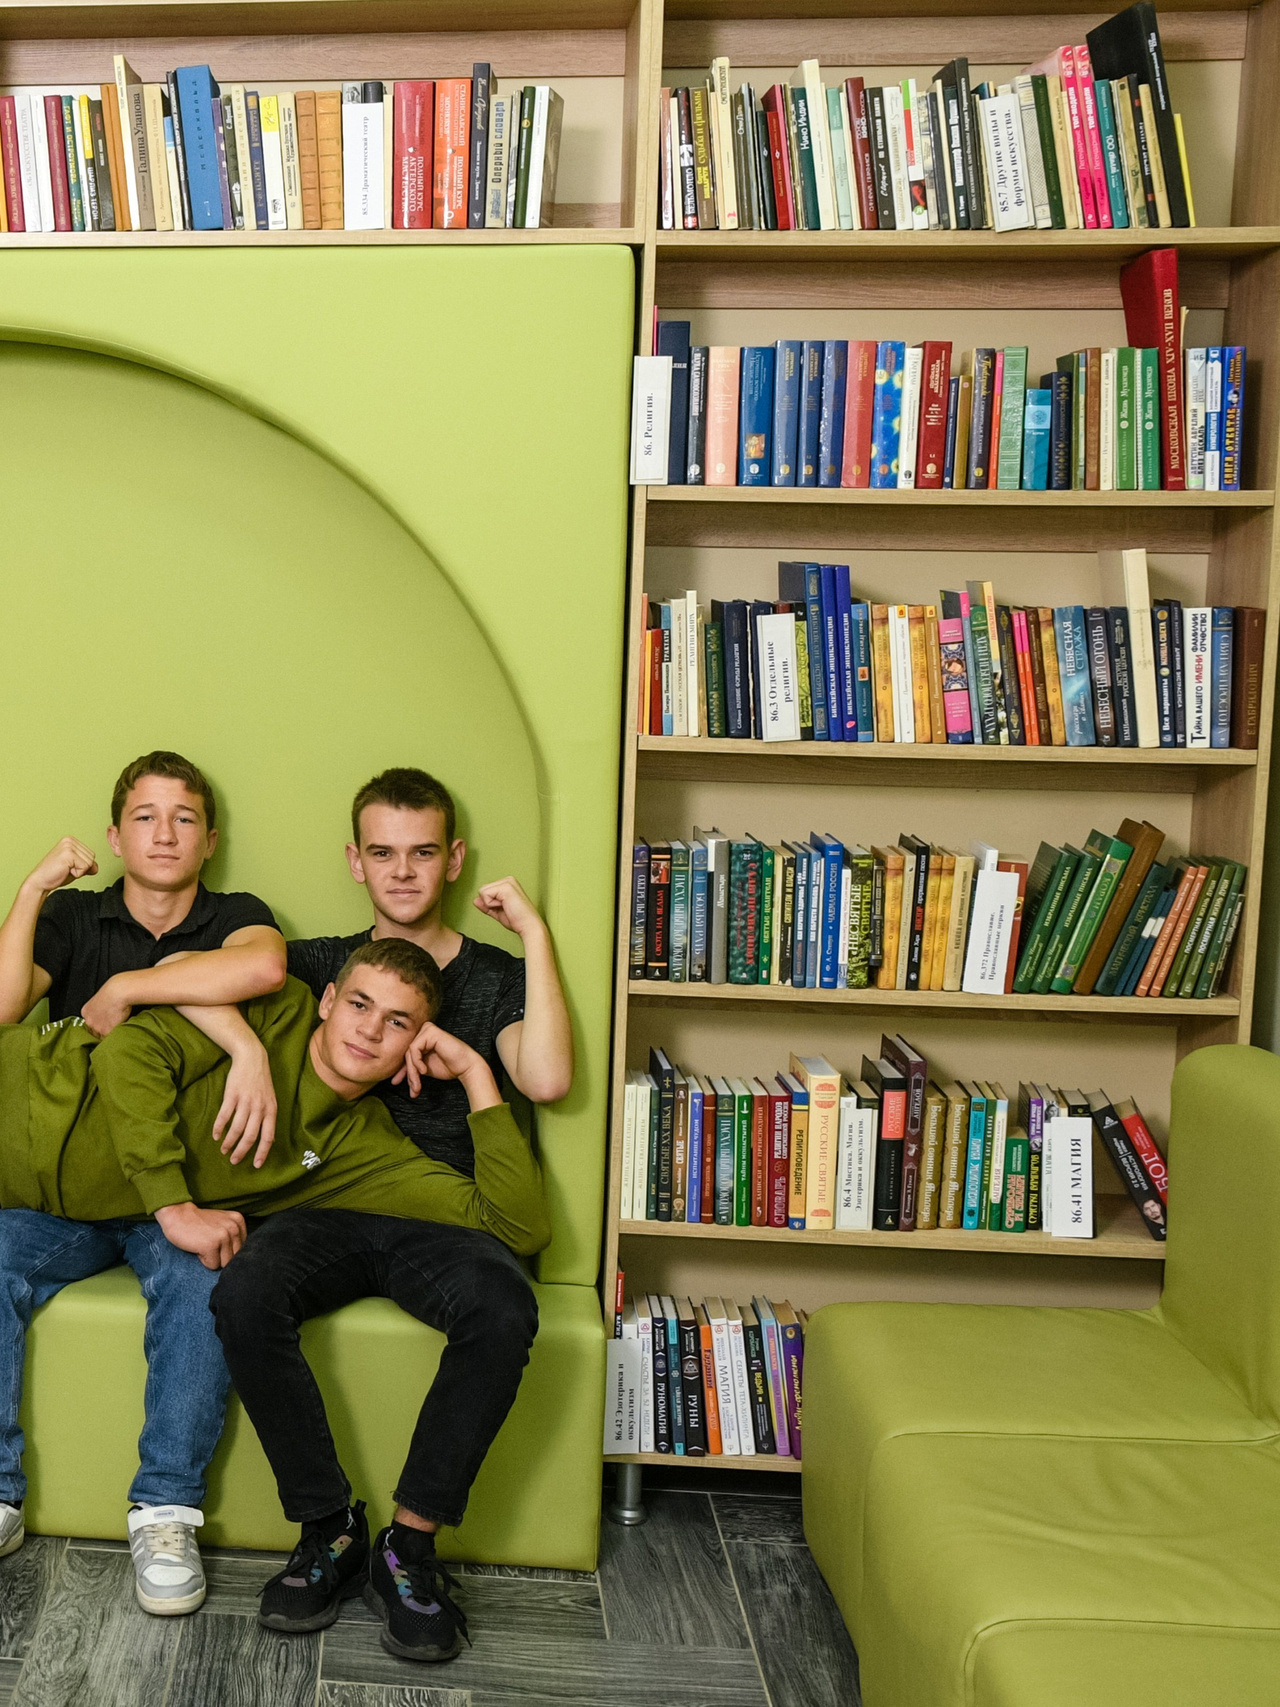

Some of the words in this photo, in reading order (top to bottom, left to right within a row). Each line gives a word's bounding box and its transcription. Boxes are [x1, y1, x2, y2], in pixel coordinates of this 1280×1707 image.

[132, 93, 144, 135] Уланова
[797, 100, 808, 126] Индии
[799, 128, 810, 149] Кино
[990, 119, 1002, 148] виды
[1003, 109, 1019, 166] искусства.
[135, 137, 147, 173] Галина
[491, 142, 503, 183] Оперный
[993, 150, 1007, 189] Другие
[998, 192, 1009, 212] 85.7
[1008, 167, 1024, 207] формы
[1164, 288, 1173, 319] ВЕКОВ
[1166, 367, 1177, 401] ИКОНА
[644, 393, 654, 438] Религия.
[643, 441, 653, 456] 86.
[1168, 405, 1179, 469] МОСКОВСКАЯ
[1073, 626, 1085, 669] СТРАЖА
[1094, 625, 1107, 663] ОГОНЬ
[1159, 622, 1168, 641] СВЕТА
[1062, 621, 1076, 676] НЕБЕСНАЯ
[1159, 643, 1169, 665] КОНЦА
[765, 641, 778, 699] Отдельные
[781, 658, 794, 703] религии.
[1195, 654, 1203, 683] ИМЕНИ
[769, 702, 780, 721] 86.3
[1096, 665, 1112, 728] НЕБЕСНЫЙ
[1160, 678, 1170, 715] варианты
[1195, 685, 1203, 713] ВАШЕГО
[1248, 663, 1258, 735] Е.ГАБРИЛОВИЧ
[1162, 717, 1171, 730] Все
[1191, 715, 1206, 743] ТАЙНА
[1056, 866, 1072, 890] ПИСЬМА
[1077, 867, 1093, 891] ПИСЬМА
[1092, 877, 1112, 909] КОРАН
[1216, 879, 1229, 895] ДУШИ
[656, 889, 664, 914] ВЕДЬМ
[1183, 917, 1202, 953] ПОСМЕРТНАЯ
[1196, 897, 1210, 916] ЖИЗНЬ
[1203, 880, 1216, 896] ДУШИ
[1210, 897, 1224, 916] ЖИЗНЬ
[656, 916, 663, 928] НА
[1108, 925, 1138, 976] МАГИЧЕСКИЙ
[1131, 885, 1159, 923] КРИСТАЛЛ
[1198, 917, 1215, 953] ПОСМЕРТНАЯ
[979, 958, 990, 980] 86.372
[662, 1106, 672, 1127] ВЕКА
[774, 1102, 782, 1130] НАРОДОВ
[662, 1130, 671, 1145] XX
[773, 1132, 782, 1159] РЕЛИГИИ
[819, 1115, 829, 1160] РУССКИЕ
[844, 1122, 854, 1148] Магия.
[856, 1119, 865, 1164] оккультизм.
[660, 1146, 670, 1184] СВЯТЫЕ
[675, 1140, 684, 1164] СВЯТЫЕ
[793, 1130, 804, 1195] РЕЛИГИОВЕДЕНИЕ
[844, 1150, 853, 1186] Мистика.
[1071, 1138, 1081, 1189] МАГИЯ
[818, 1163, 827, 1203] СВЯТЫЕ
[1128, 1155, 1149, 1190] АСТРОЛОГИЯ
[773, 1176, 786, 1224] СЛОВАРЬ
[843, 1189, 852, 1208] 86.4
[855, 1173, 864, 1211] Эзотерика
[1072, 1194, 1082, 1223] 86.41
[719, 1365, 731, 1404] МАГИЯ
[736, 1360, 745, 1388] СЕКРЕТЫ
[755, 1372, 764, 1394] ВЕДЬМА
[616, 1371, 625, 1416] Эзотерика
[643, 1387, 649, 1396] ЗА
[658, 1383, 666, 1434] РУНОМАГИЯ
[688, 1395, 699, 1428] РУНЫ
[739, 1391, 749, 1439] ТЕТА-ХИЛИНГА
[616, 1419, 624, 1440] 86.42
